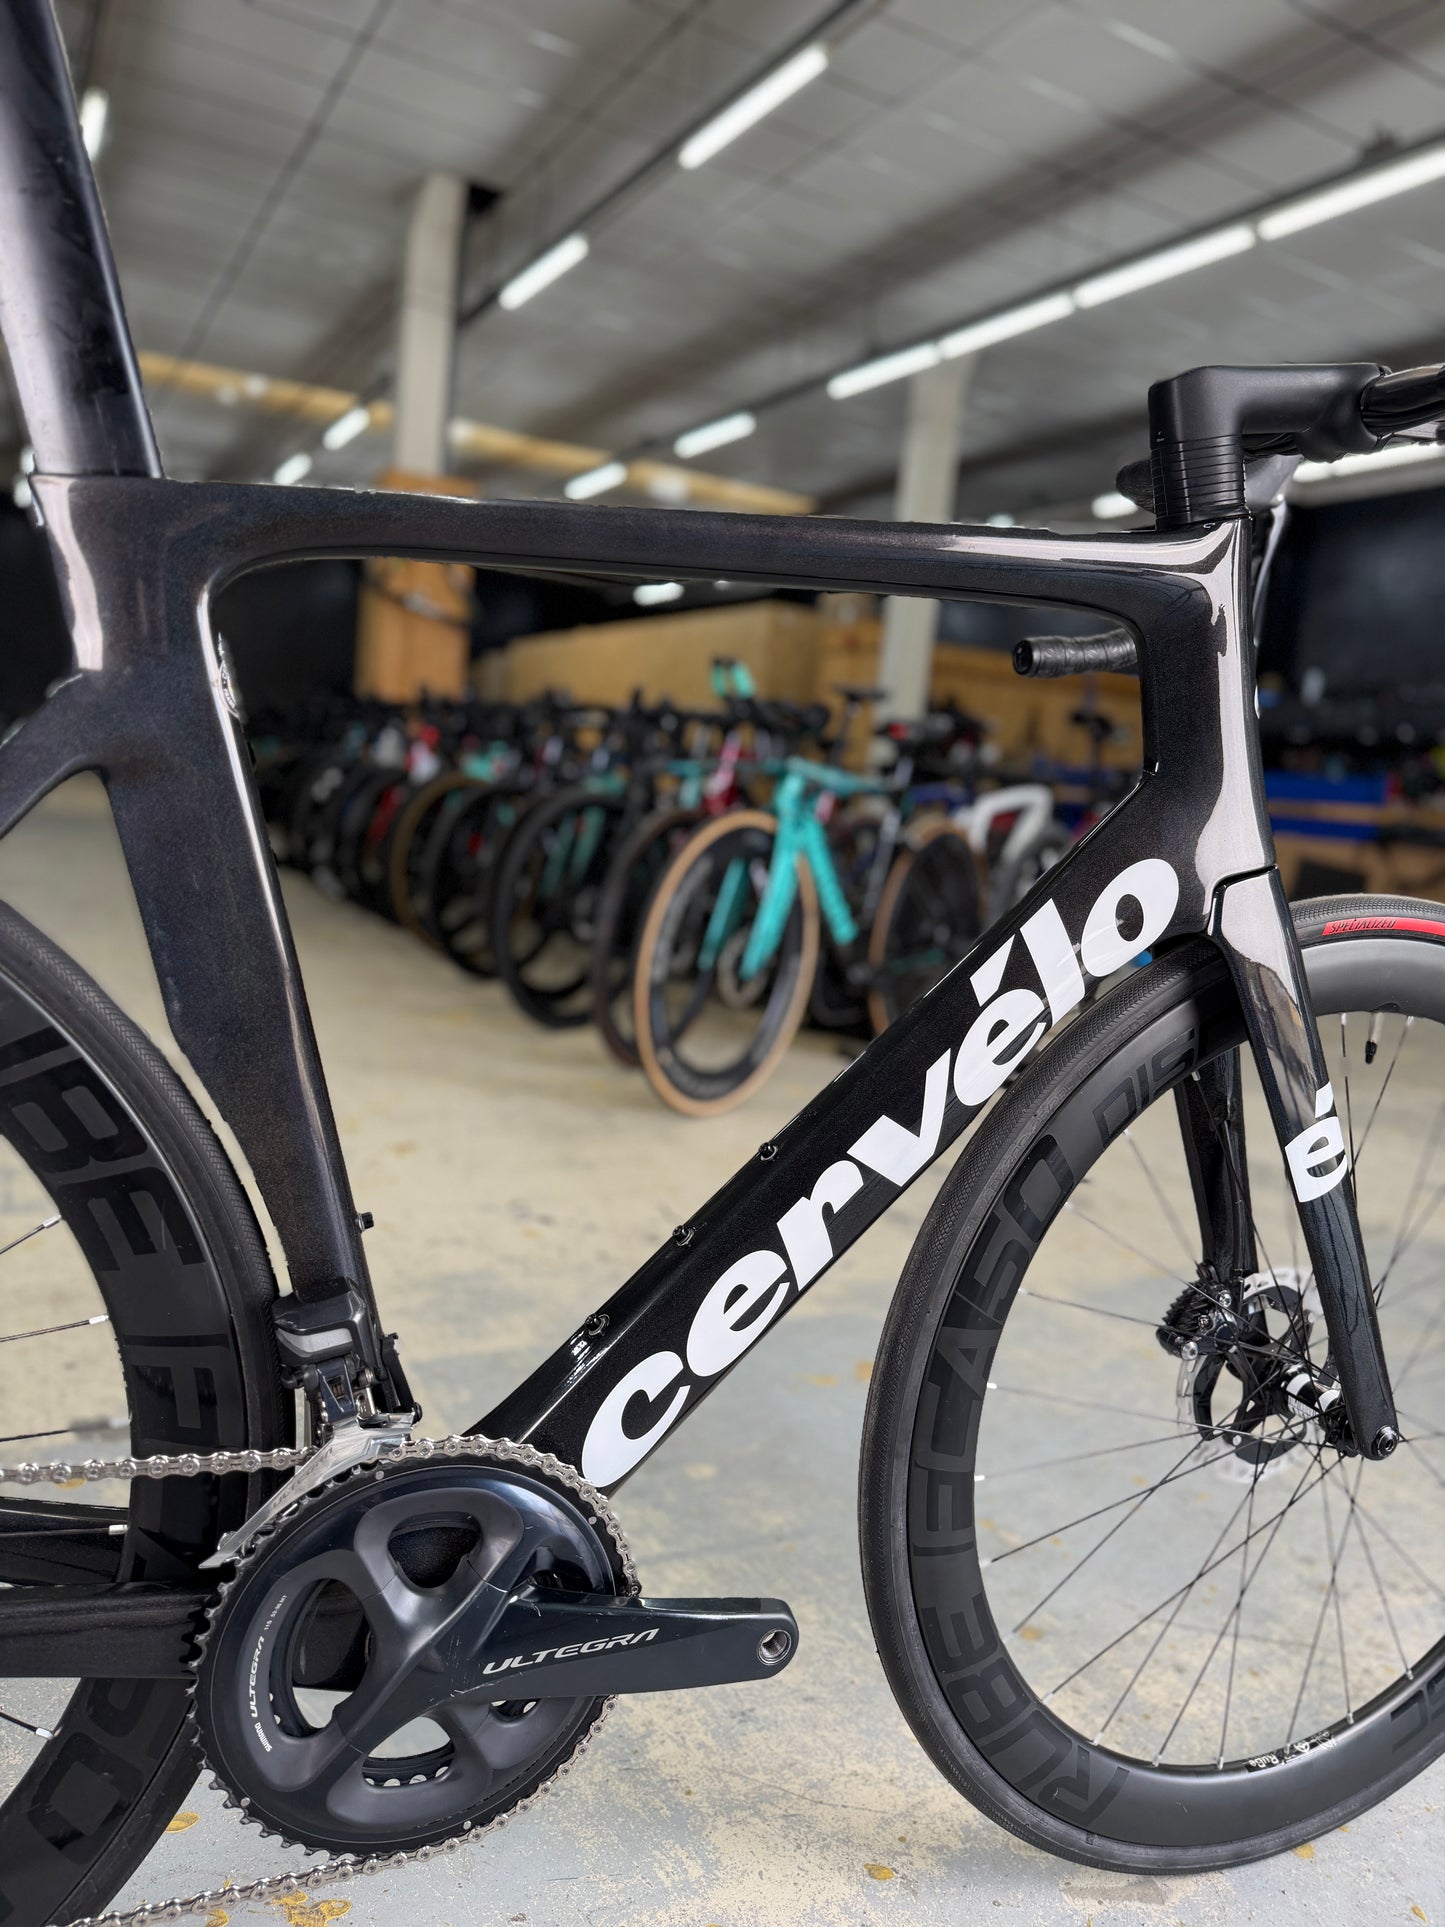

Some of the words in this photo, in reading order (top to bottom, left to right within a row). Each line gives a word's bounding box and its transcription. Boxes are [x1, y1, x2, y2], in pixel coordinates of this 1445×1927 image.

[1328, 918, 1398, 934] SPECIALIZED
[579, 857, 1180, 1488] cervélo
[249, 1635, 265, 1719] ULTEGRA
[482, 1628, 660, 1675] ULTEGRA
[254, 1721, 273, 1753] SHIMANO
[920, 1590, 1130, 1827] RUBE
